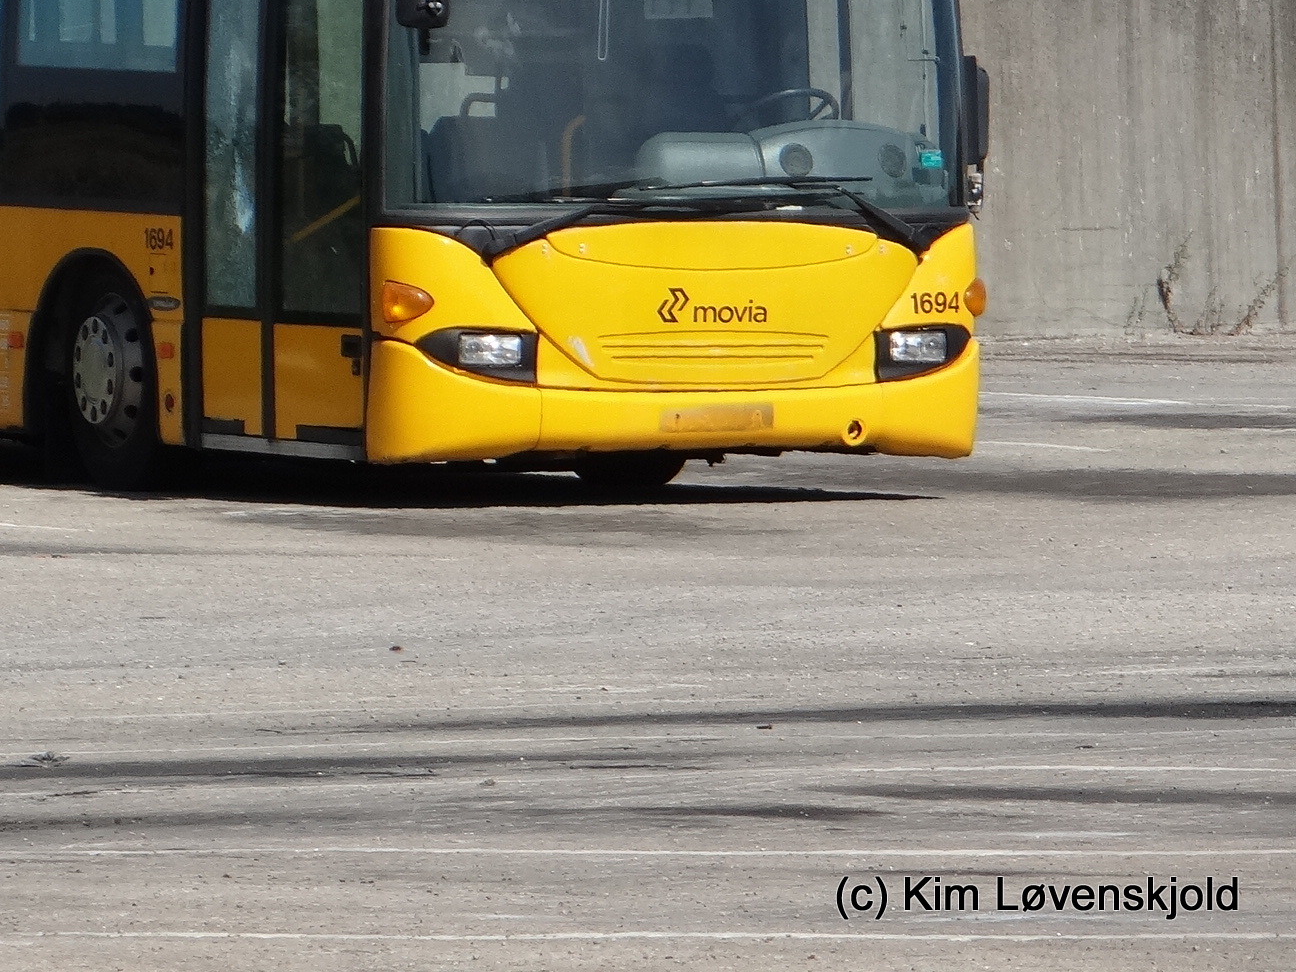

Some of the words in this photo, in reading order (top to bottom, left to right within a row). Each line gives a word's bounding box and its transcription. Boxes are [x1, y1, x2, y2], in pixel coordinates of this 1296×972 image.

[144, 227, 174, 250] 1694
[692, 299, 768, 324] movia
[910, 291, 960, 315] 1694
